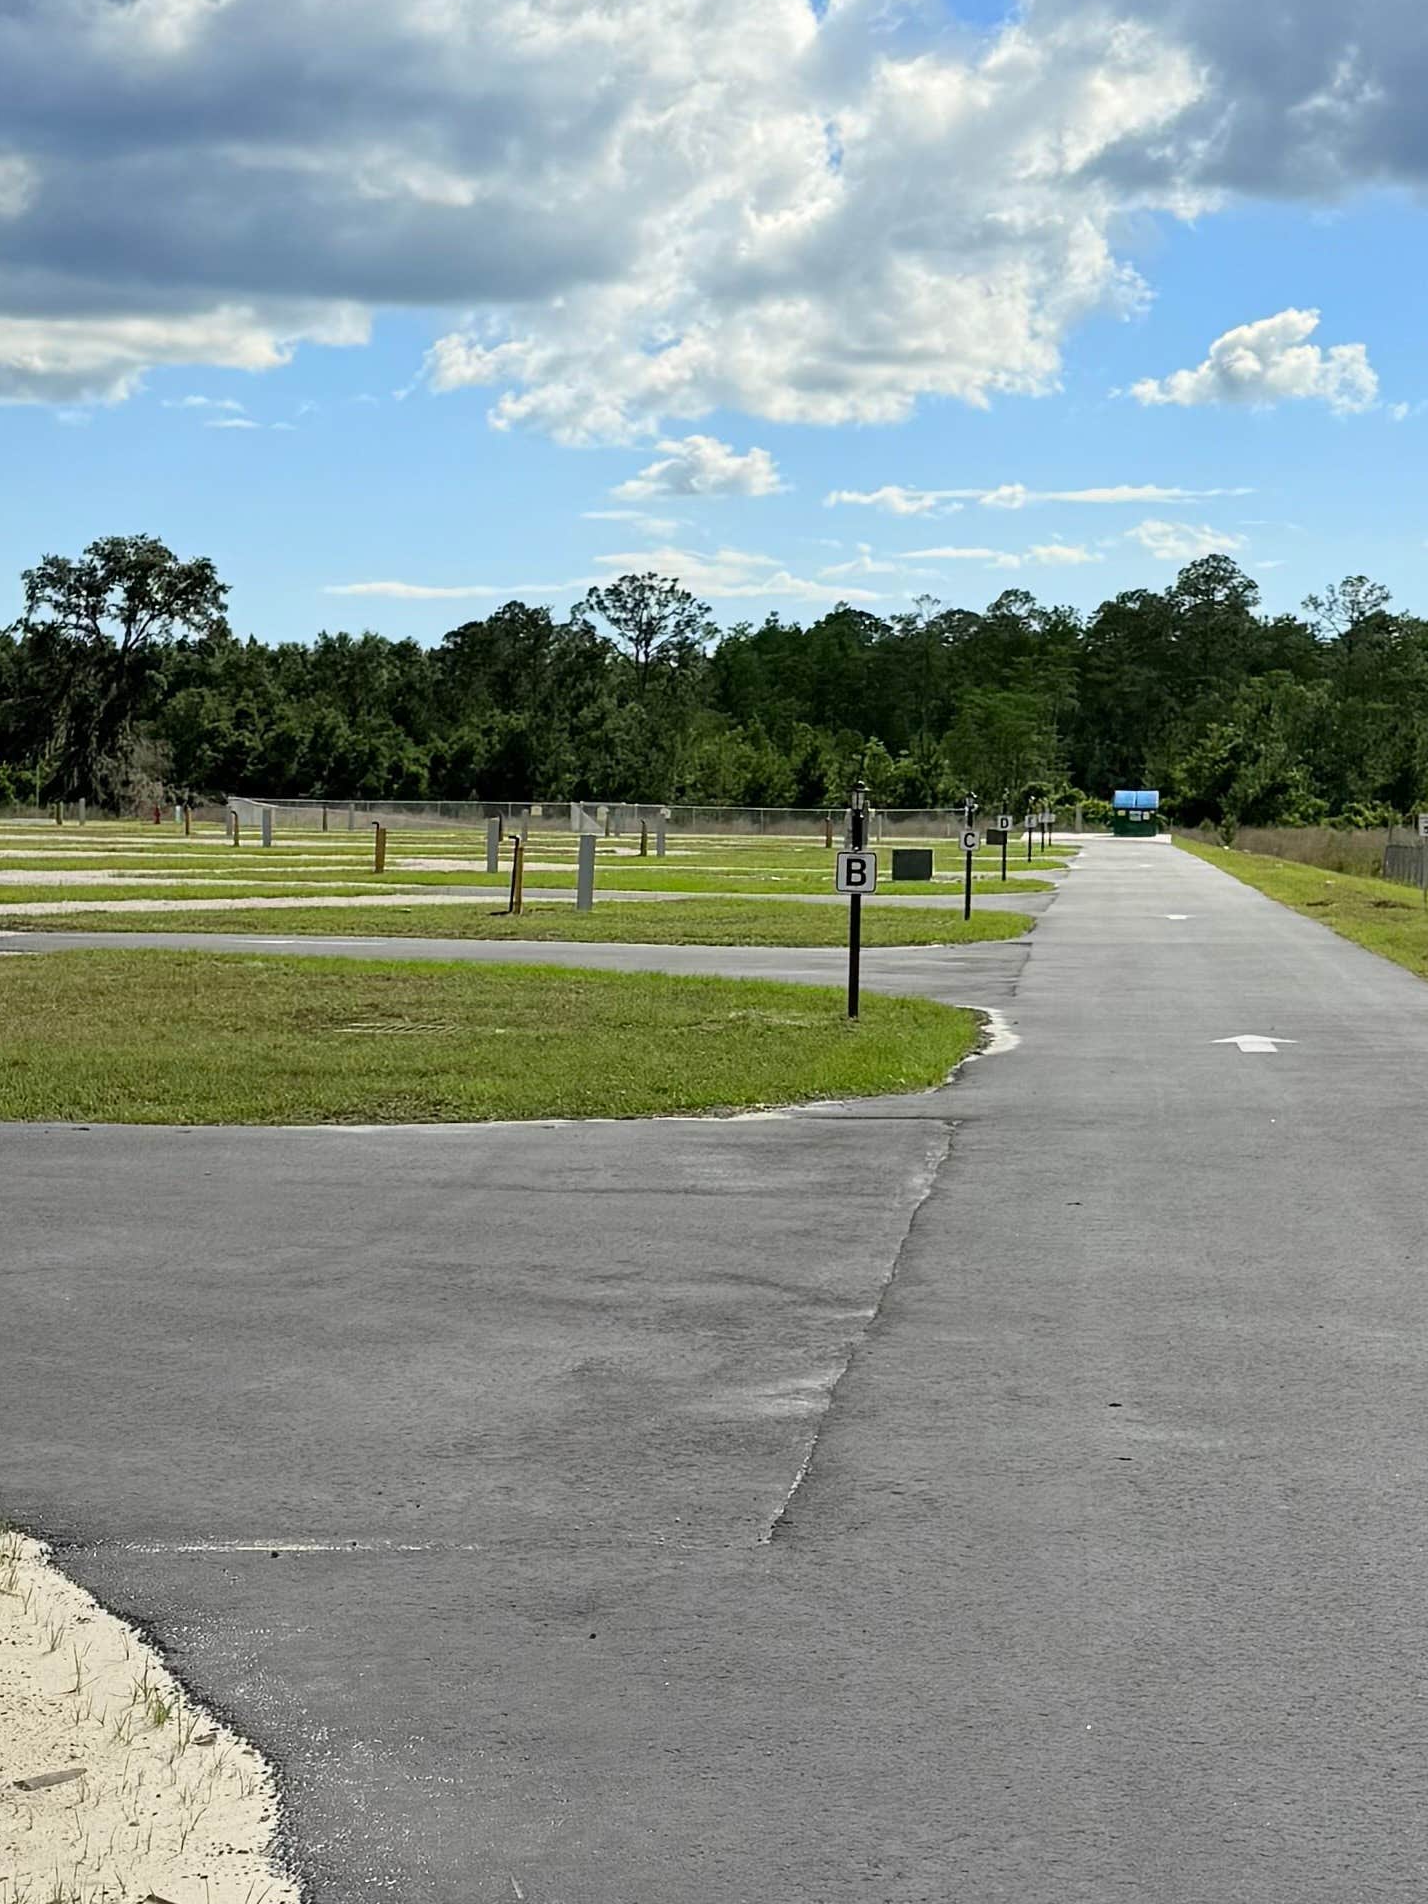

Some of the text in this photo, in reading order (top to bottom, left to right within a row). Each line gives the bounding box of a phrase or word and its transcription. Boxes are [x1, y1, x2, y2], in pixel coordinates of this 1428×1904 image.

[1000, 817, 1009, 829] D
[963, 832, 975, 848] C
[845, 858, 867, 886] B
